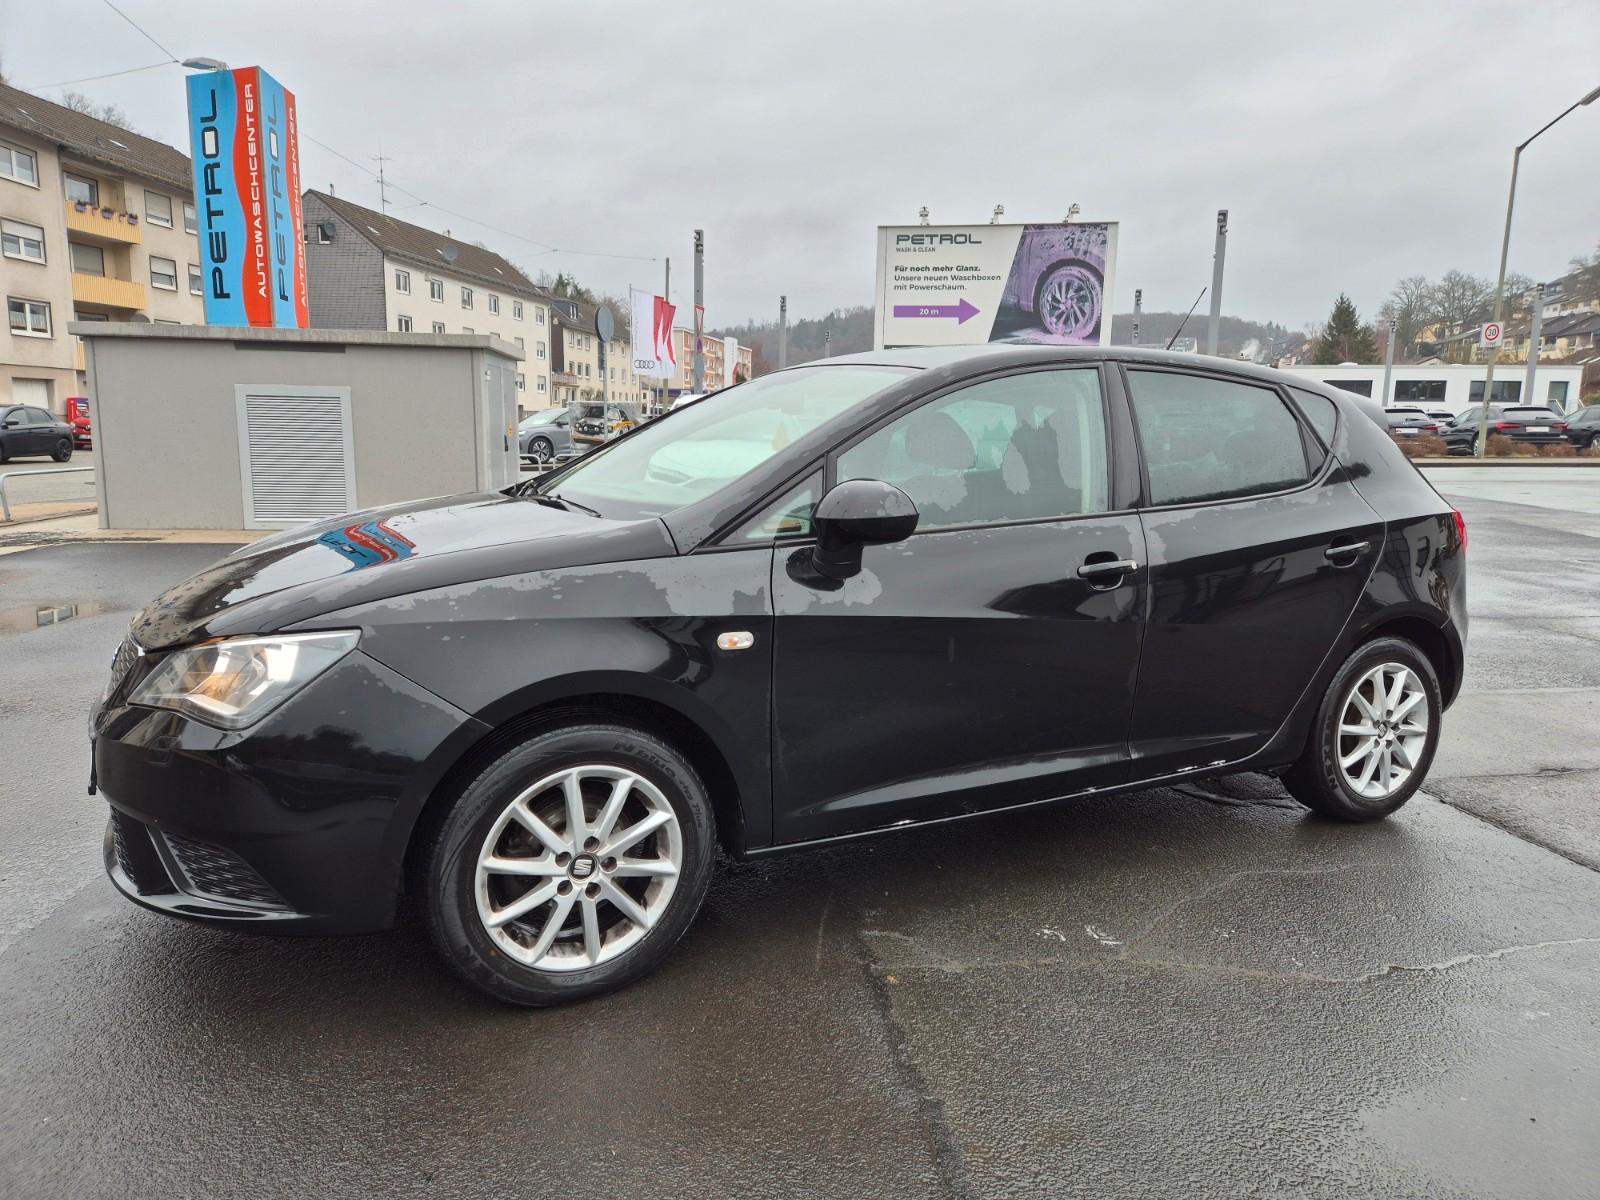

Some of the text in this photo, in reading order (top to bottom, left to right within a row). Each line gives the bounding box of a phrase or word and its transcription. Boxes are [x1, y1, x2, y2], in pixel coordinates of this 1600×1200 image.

[200, 88, 231, 300] PETROL
[244, 83, 267, 298] AUTOWASCHCENTER
[268, 94, 289, 301] PETROL
[289, 107, 307, 307] AUTOWASCHCENTER
[896, 233, 982, 245] PETROL
[909, 283, 967, 291] Powerschaum.
[1487, 328, 1497, 337] 30
